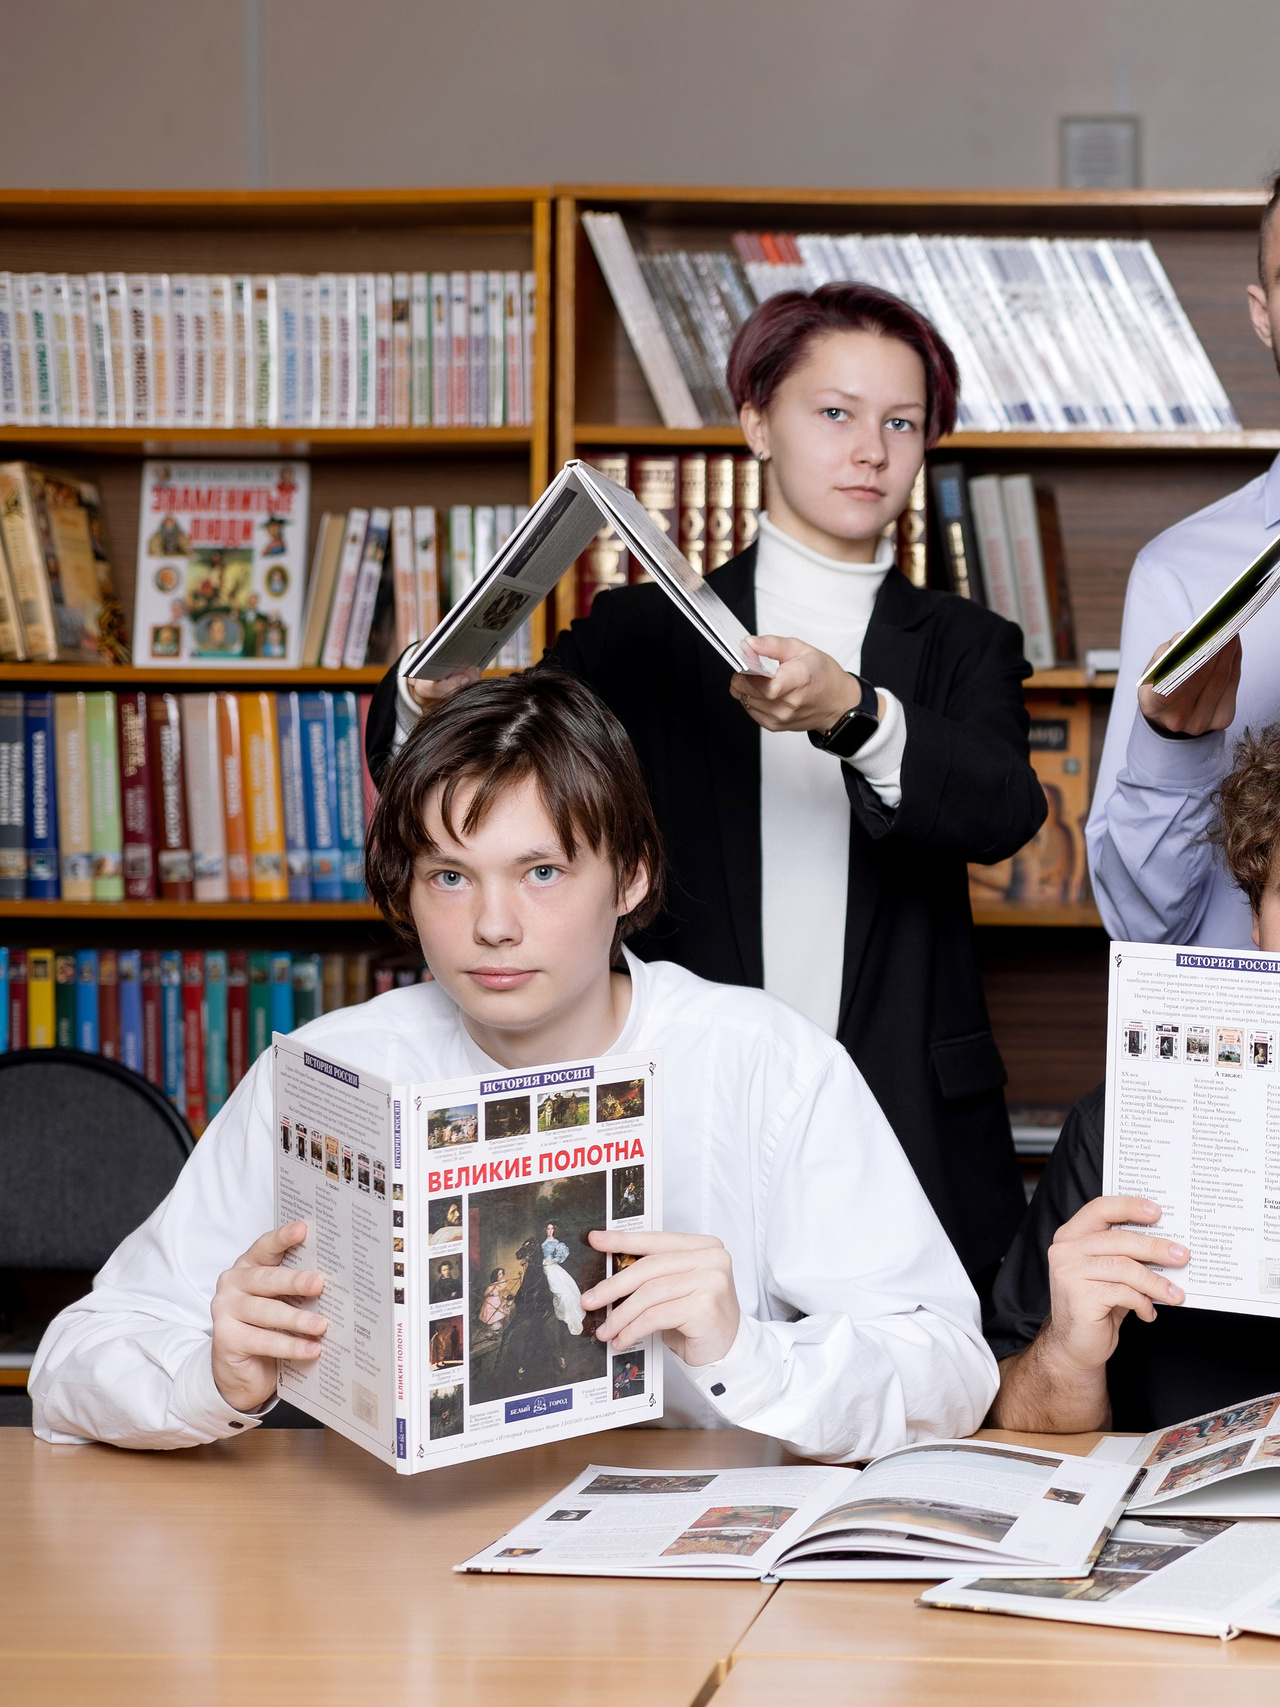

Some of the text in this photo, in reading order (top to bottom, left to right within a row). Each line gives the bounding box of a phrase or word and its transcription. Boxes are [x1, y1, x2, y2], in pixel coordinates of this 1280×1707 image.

[153, 486, 292, 513] ЗНАМЕНИТЫЕ
[190, 519, 253, 549] ЛЮДИ
[32, 731, 47, 839] ИНФОРМАТИКА
[1180, 955, 1235, 969] ИСТОРИЯ
[306, 1055, 358, 1087] ИСТОРИЯ РОССИИ
[483, 1067, 592, 1094] ИСТОРИЯ РОССИИ
[428, 1157, 532, 1193] ВЕЛИКИЕ
[539, 1139, 645, 1175] ПОЛОТНА
[510, 1398, 568, 1416] БЕЛЫЙ ГОРОД
